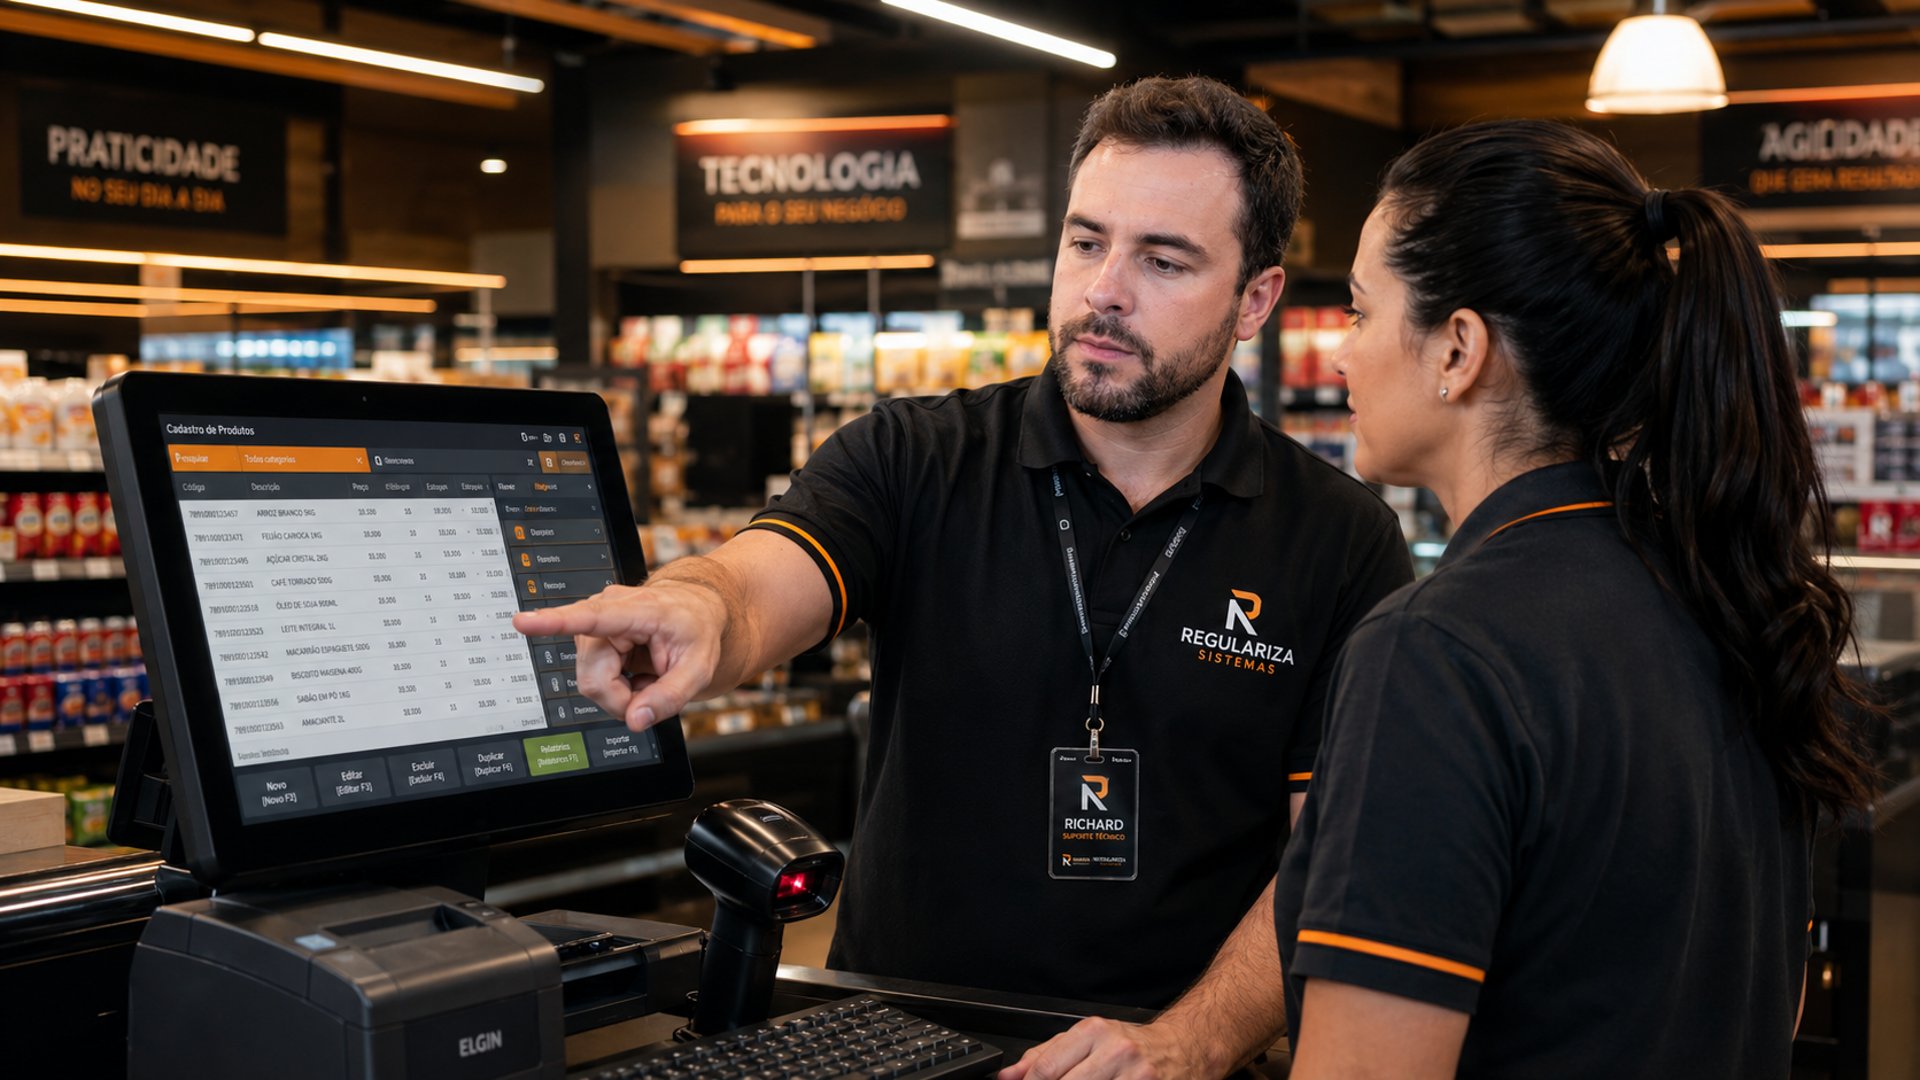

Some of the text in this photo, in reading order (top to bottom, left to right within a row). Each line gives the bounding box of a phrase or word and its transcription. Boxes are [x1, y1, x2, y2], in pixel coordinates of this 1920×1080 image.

[48, 126, 240, 182] PRATICIDADE
[700, 152, 921, 194] TECNOLOGIA
[166, 424, 255, 436] Cadastro de Produtos
[1181, 627, 1295, 666] REGULARIZA
[1198, 649, 1276, 675] SISTEMAS
[266, 781, 287, 791] Novo
[341, 770, 363, 782] Editar
[1065, 818, 1124, 831] RICHARD
[459, 1029, 503, 1057] ELGIN
